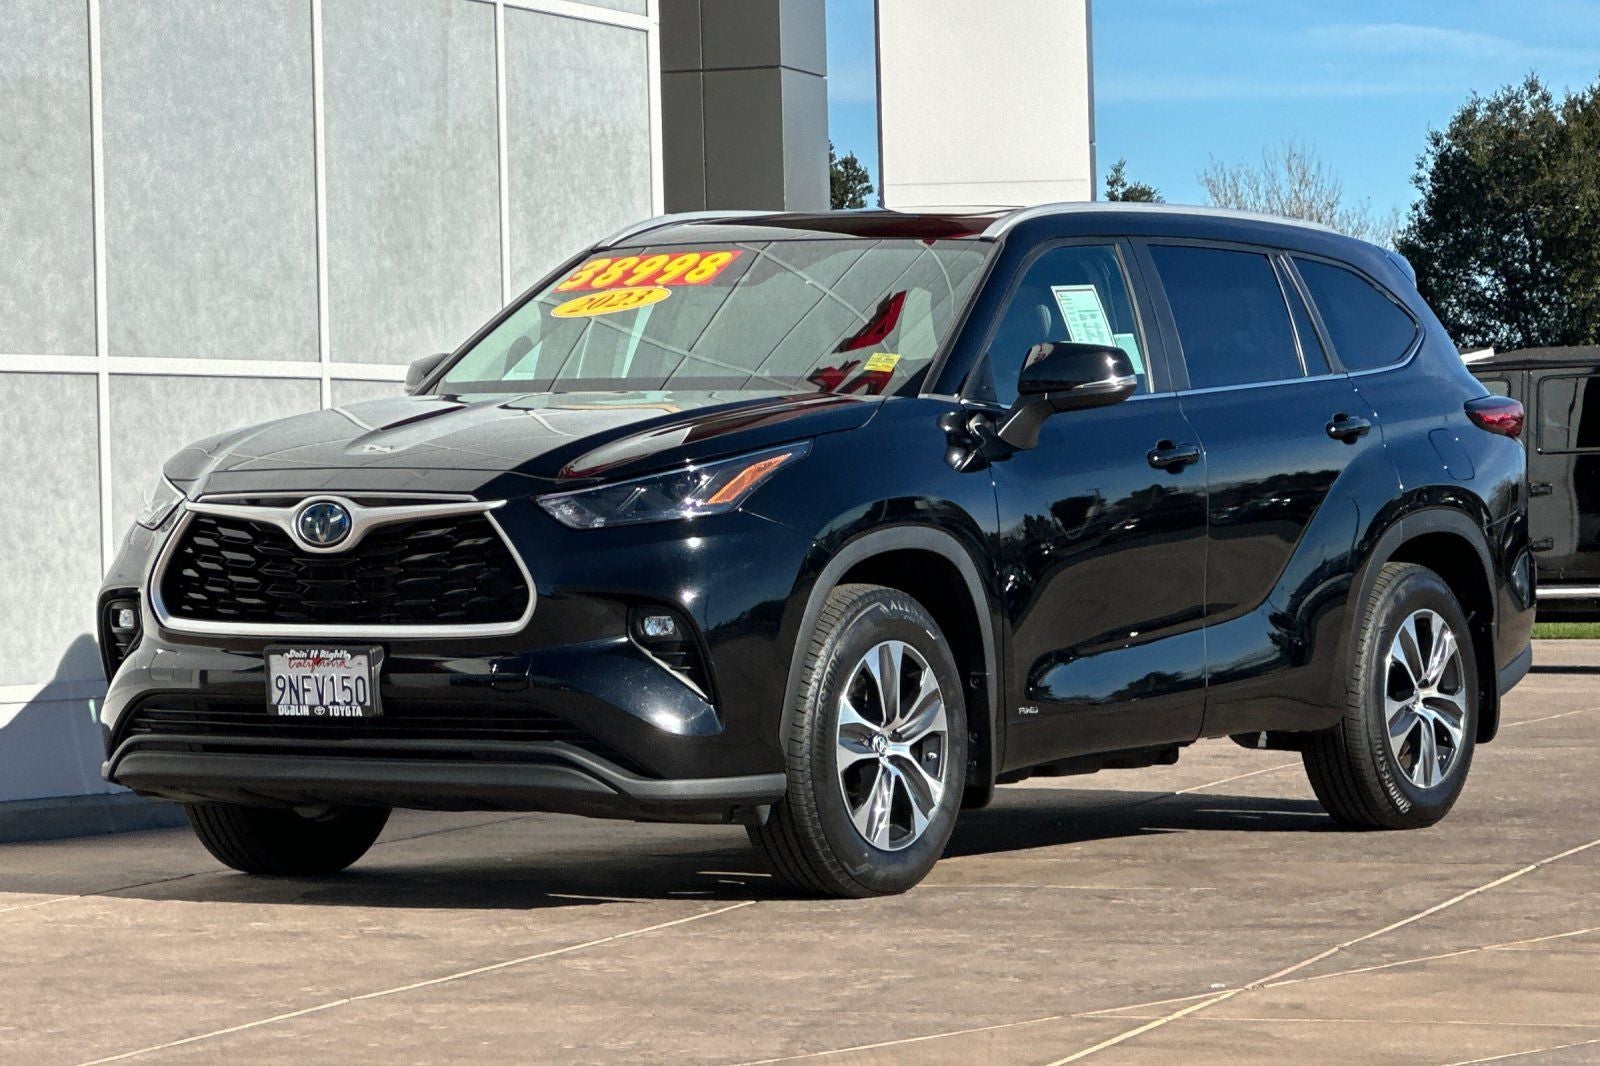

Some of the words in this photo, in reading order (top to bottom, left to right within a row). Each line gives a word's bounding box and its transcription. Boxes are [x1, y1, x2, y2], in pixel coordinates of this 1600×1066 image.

[558, 252, 732, 290] 38998
[567, 289, 654, 314] 2023
[275, 675, 366, 705] 9NFV150
[278, 705, 310, 716] DUBLIN
[328, 705, 363, 717] TOYOTA
